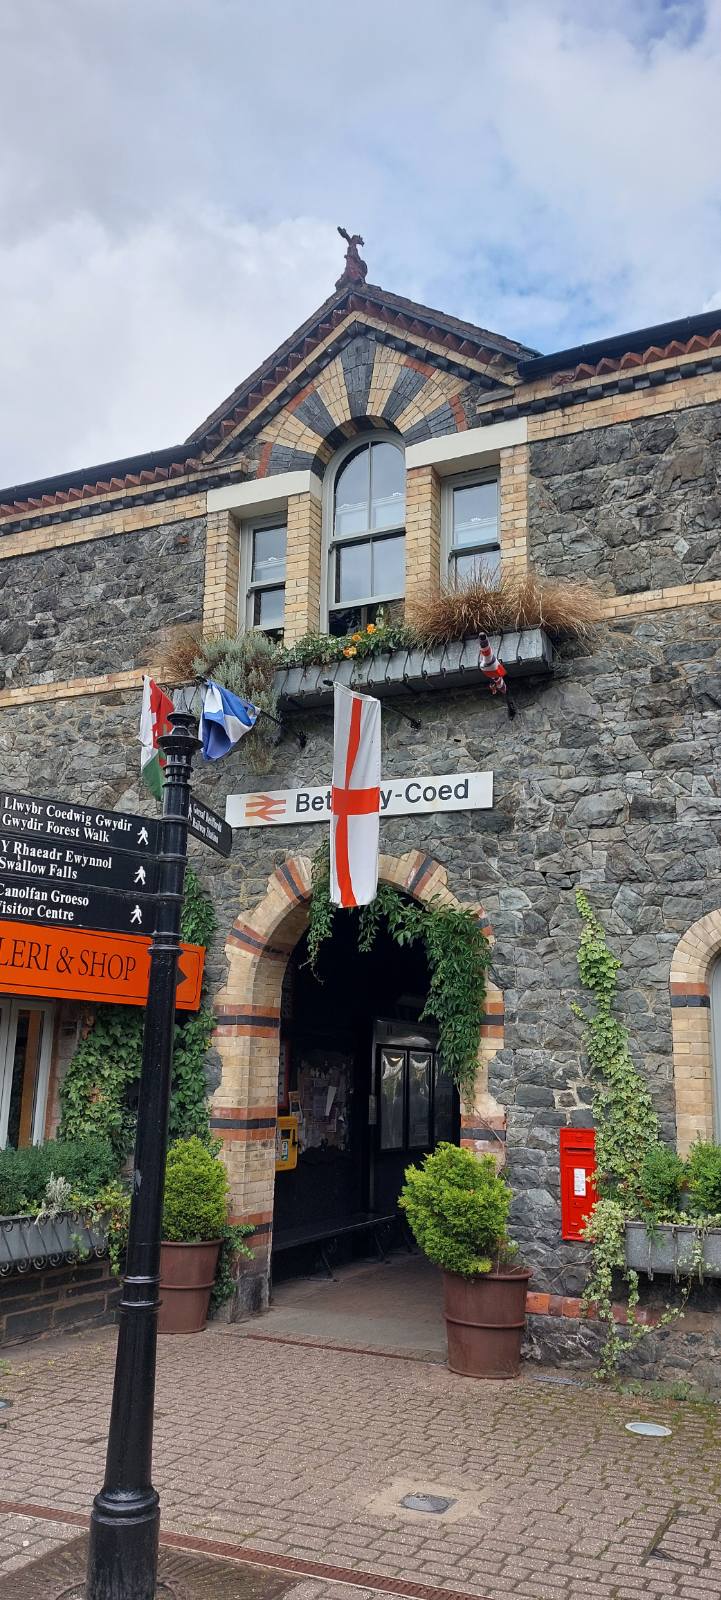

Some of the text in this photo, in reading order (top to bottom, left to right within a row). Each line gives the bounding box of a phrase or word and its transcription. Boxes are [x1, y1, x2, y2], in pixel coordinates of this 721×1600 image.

[295, 778, 469, 813] Bety-Coed
[2, 813, 110, 843] Gwydir Forest Walk
[4, 797, 133, 832] Llwybr Coedwig Gwydir
[0, 857, 78, 880] Swallow Falls
[1, 840, 113, 869] Y Rhaeadr Ewynnol
[50, 888, 90, 906] Groeso
[37, 904, 75, 921] Centre
[56, 946, 75, 975] &
[78, 949, 137, 981] SHOP
